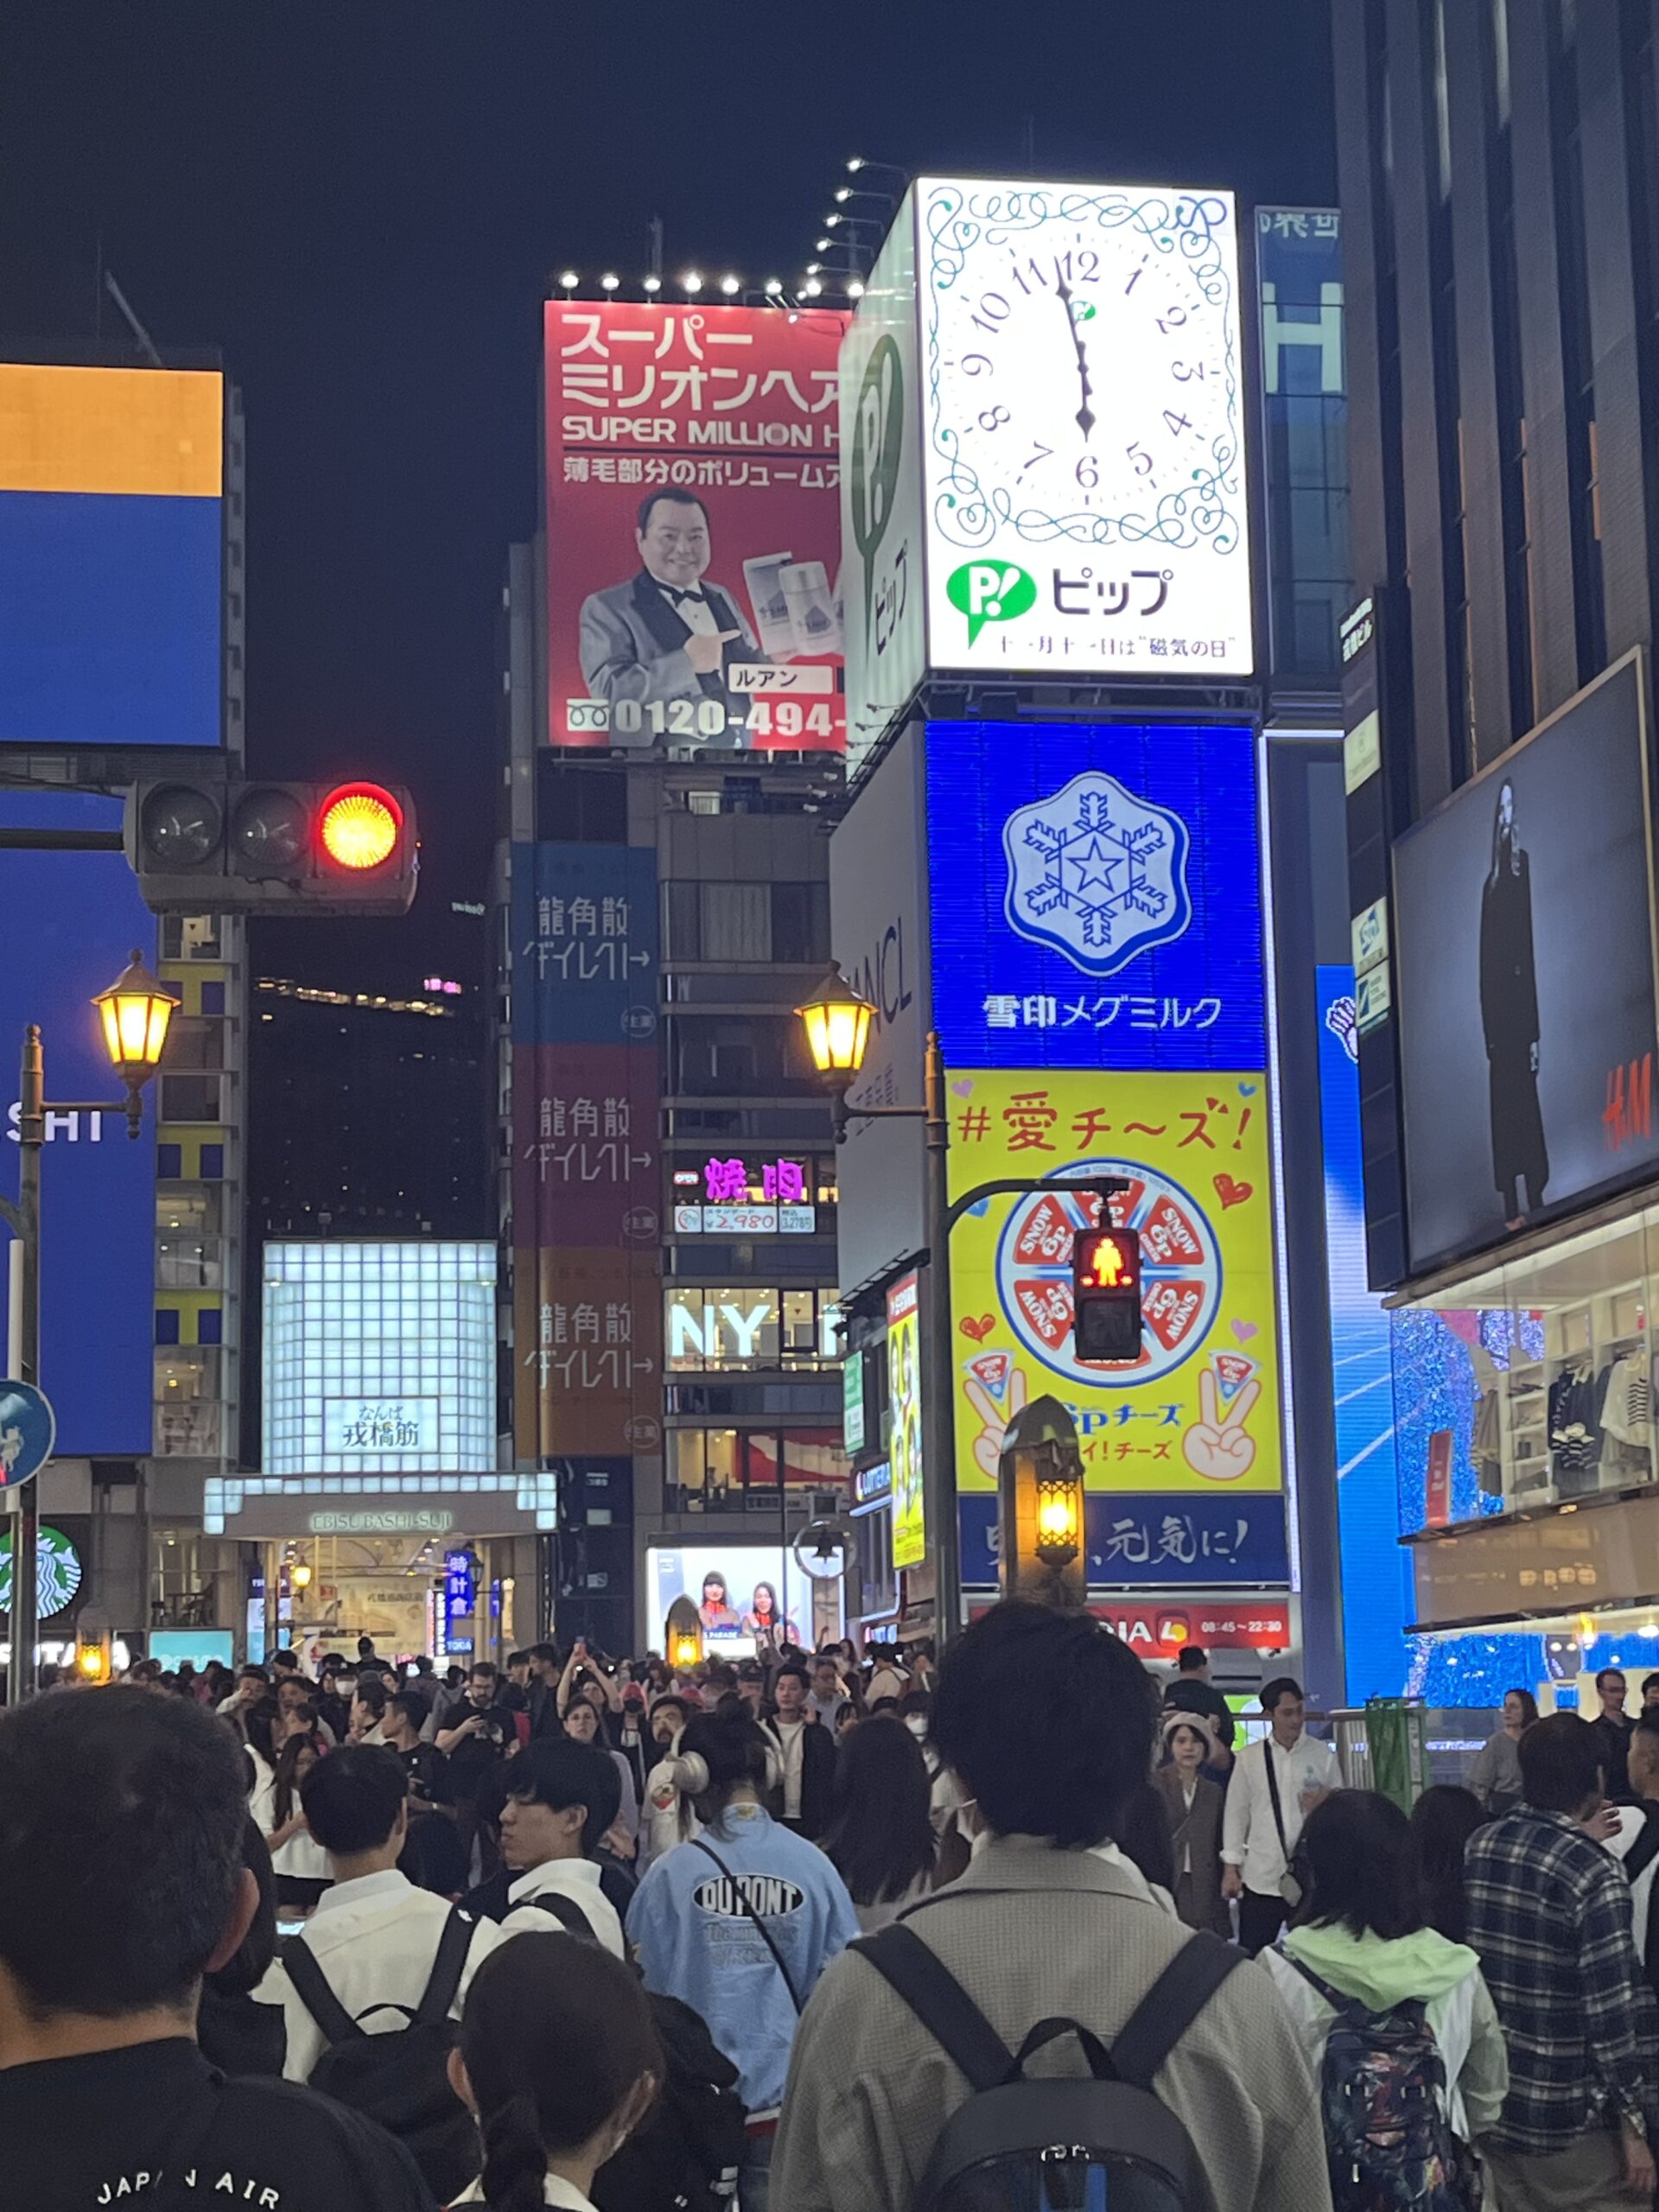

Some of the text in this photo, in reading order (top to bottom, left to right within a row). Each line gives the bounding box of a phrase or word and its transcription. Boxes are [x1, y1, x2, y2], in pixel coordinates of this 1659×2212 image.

[1013, 257, 1047, 295] 11
[1060, 251, 1100, 282] 12
[1125, 269, 1142, 296] 1
[970, 292, 1010, 333] 10
[1154, 306, 1187, 334] 2
[562, 315, 753, 360] スーパー
[961, 353, 993, 376] 9
[1171, 361, 1205, 382] 3
[562, 364, 840, 413] ミリオンヘア
[563, 416, 676, 442] SUPER
[689, 420, 812, 448] MILLION
[978, 405, 1010, 431] 8
[1163, 410, 1192, 435] 4
[1023, 441, 1054, 469] 7
[1076, 456, 1098, 488] 6
[1126, 442, 1153, 475] 5
[875, 539, 907, 657] ピップ
[969, 566, 1021, 617] P!
[1053, 567, 1174, 616] ピップ
[736, 670, 798, 688] ルアン
[539, 896, 628, 937] 龍角散
[983, 994, 1222, 1029] 雪印メグミルク
[540, 1097, 630, 1137] 龍角散
[704, 1158, 804, 1200] 焼肉
[1020, 1205, 1053, 1255] SNOW
[1161, 1208, 1198, 1255] SNOW
[539, 1302, 632, 1344] 龍角散
[671, 1304, 771, 1357] NY
[1020, 1290, 1058, 1338] SNOW
[1166, 1290, 1198, 1340] SNOW
[359, 1406, 404, 1421] なんば
[343, 1421, 419, 1447] 戎橋筋
[702, 1876, 798, 1916] DUPONT
[97, 2168, 279, 2210] JAPN AIR
